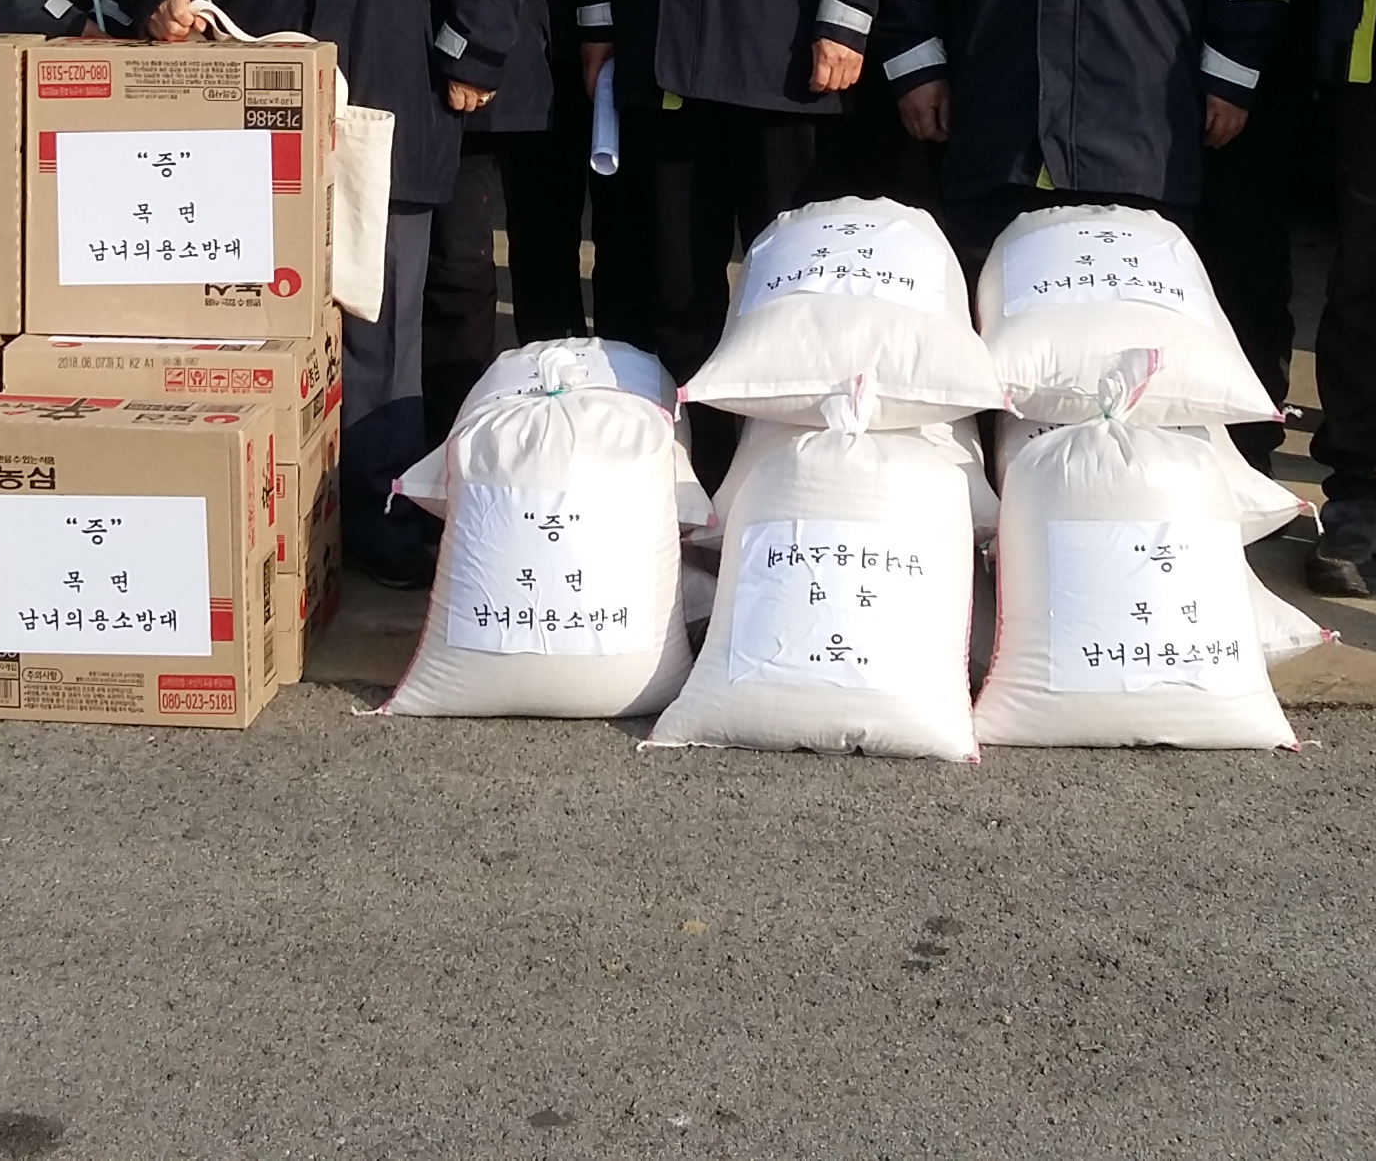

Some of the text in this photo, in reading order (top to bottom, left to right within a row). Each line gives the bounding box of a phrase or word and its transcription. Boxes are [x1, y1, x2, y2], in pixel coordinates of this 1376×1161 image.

[41, 65, 108, 81] 080-023-5181
[247, 110, 300, 128] 가3486
[132, 201, 196, 225] 목 면
[129, 357, 140, 368] K2
[145, 357, 154, 368] A1
[62, 569, 130, 595] 목 면
[515, 567, 583, 593] 목 면
[1128, 599, 1199, 627] 목 면
[162, 693, 233, 711] 080-023-5181
